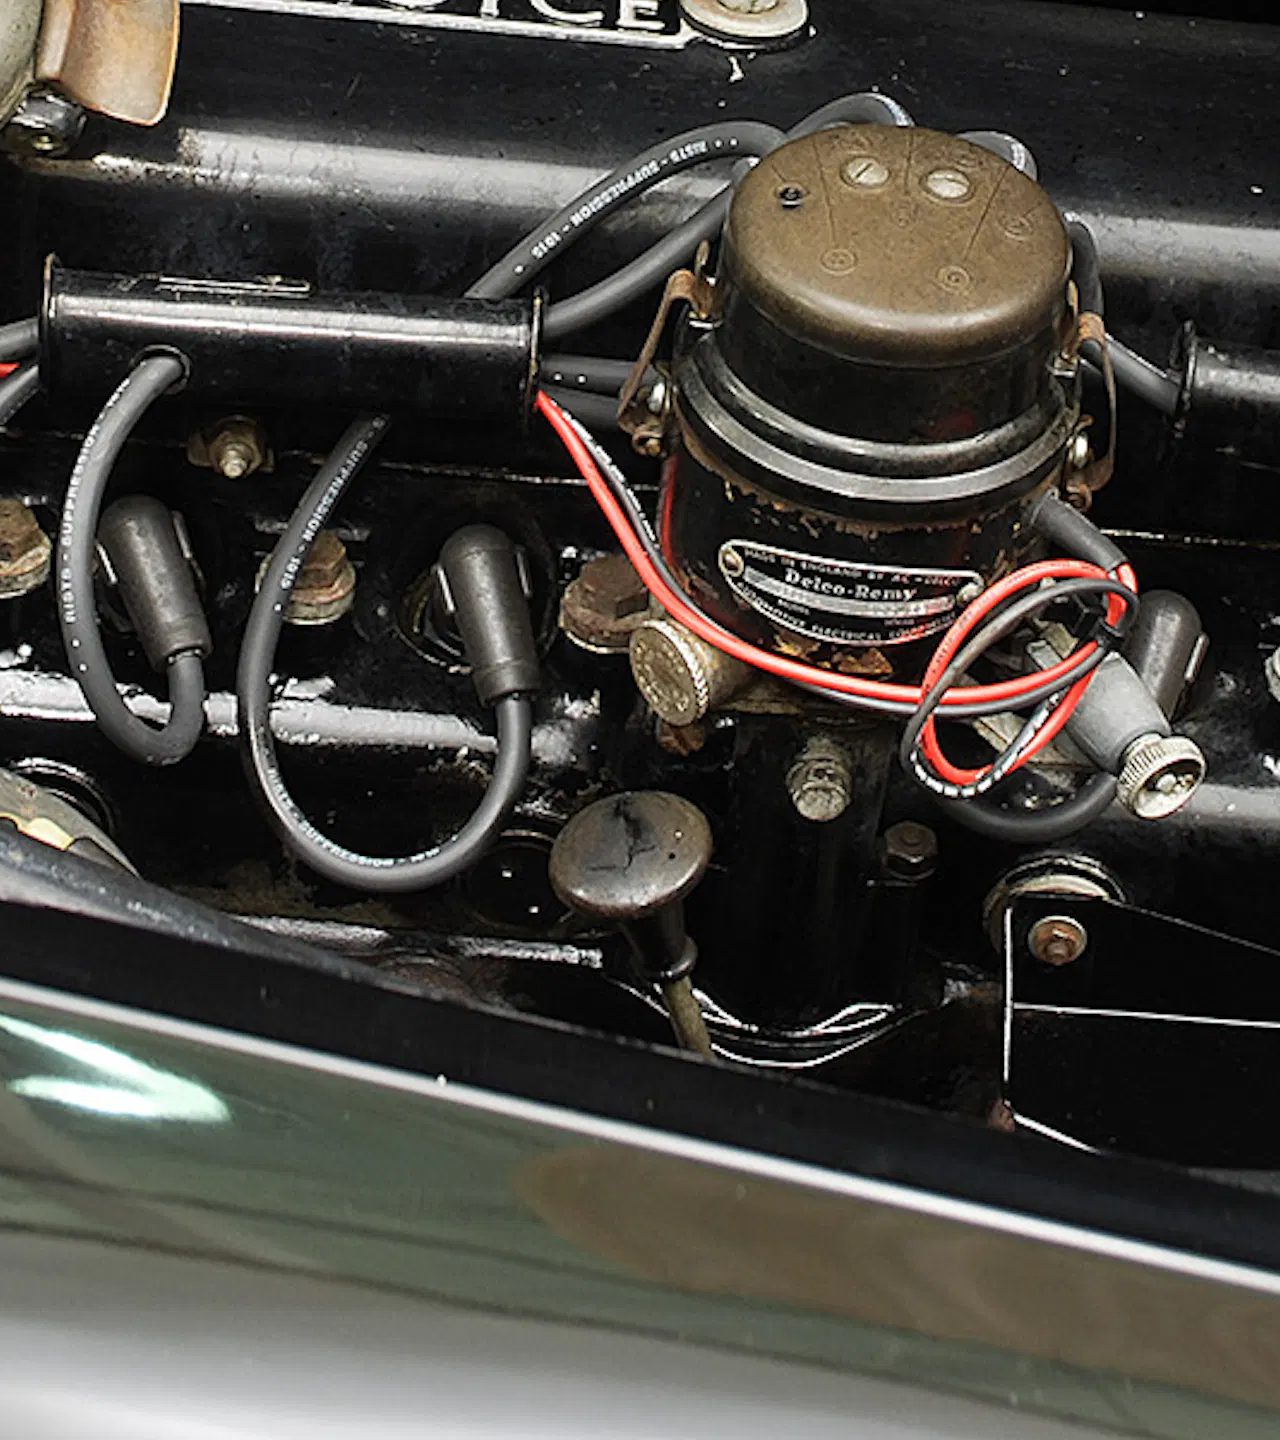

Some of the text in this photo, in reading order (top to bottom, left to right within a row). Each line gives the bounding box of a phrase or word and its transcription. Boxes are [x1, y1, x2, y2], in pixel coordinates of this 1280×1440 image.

[569, 159, 661, 228] SUPPRESSION
[61, 423, 101, 547] SUPPRESSION
[301, 439, 369, 542] SUPPRESSION
[784, 566, 919, 602] Delco-Remy
